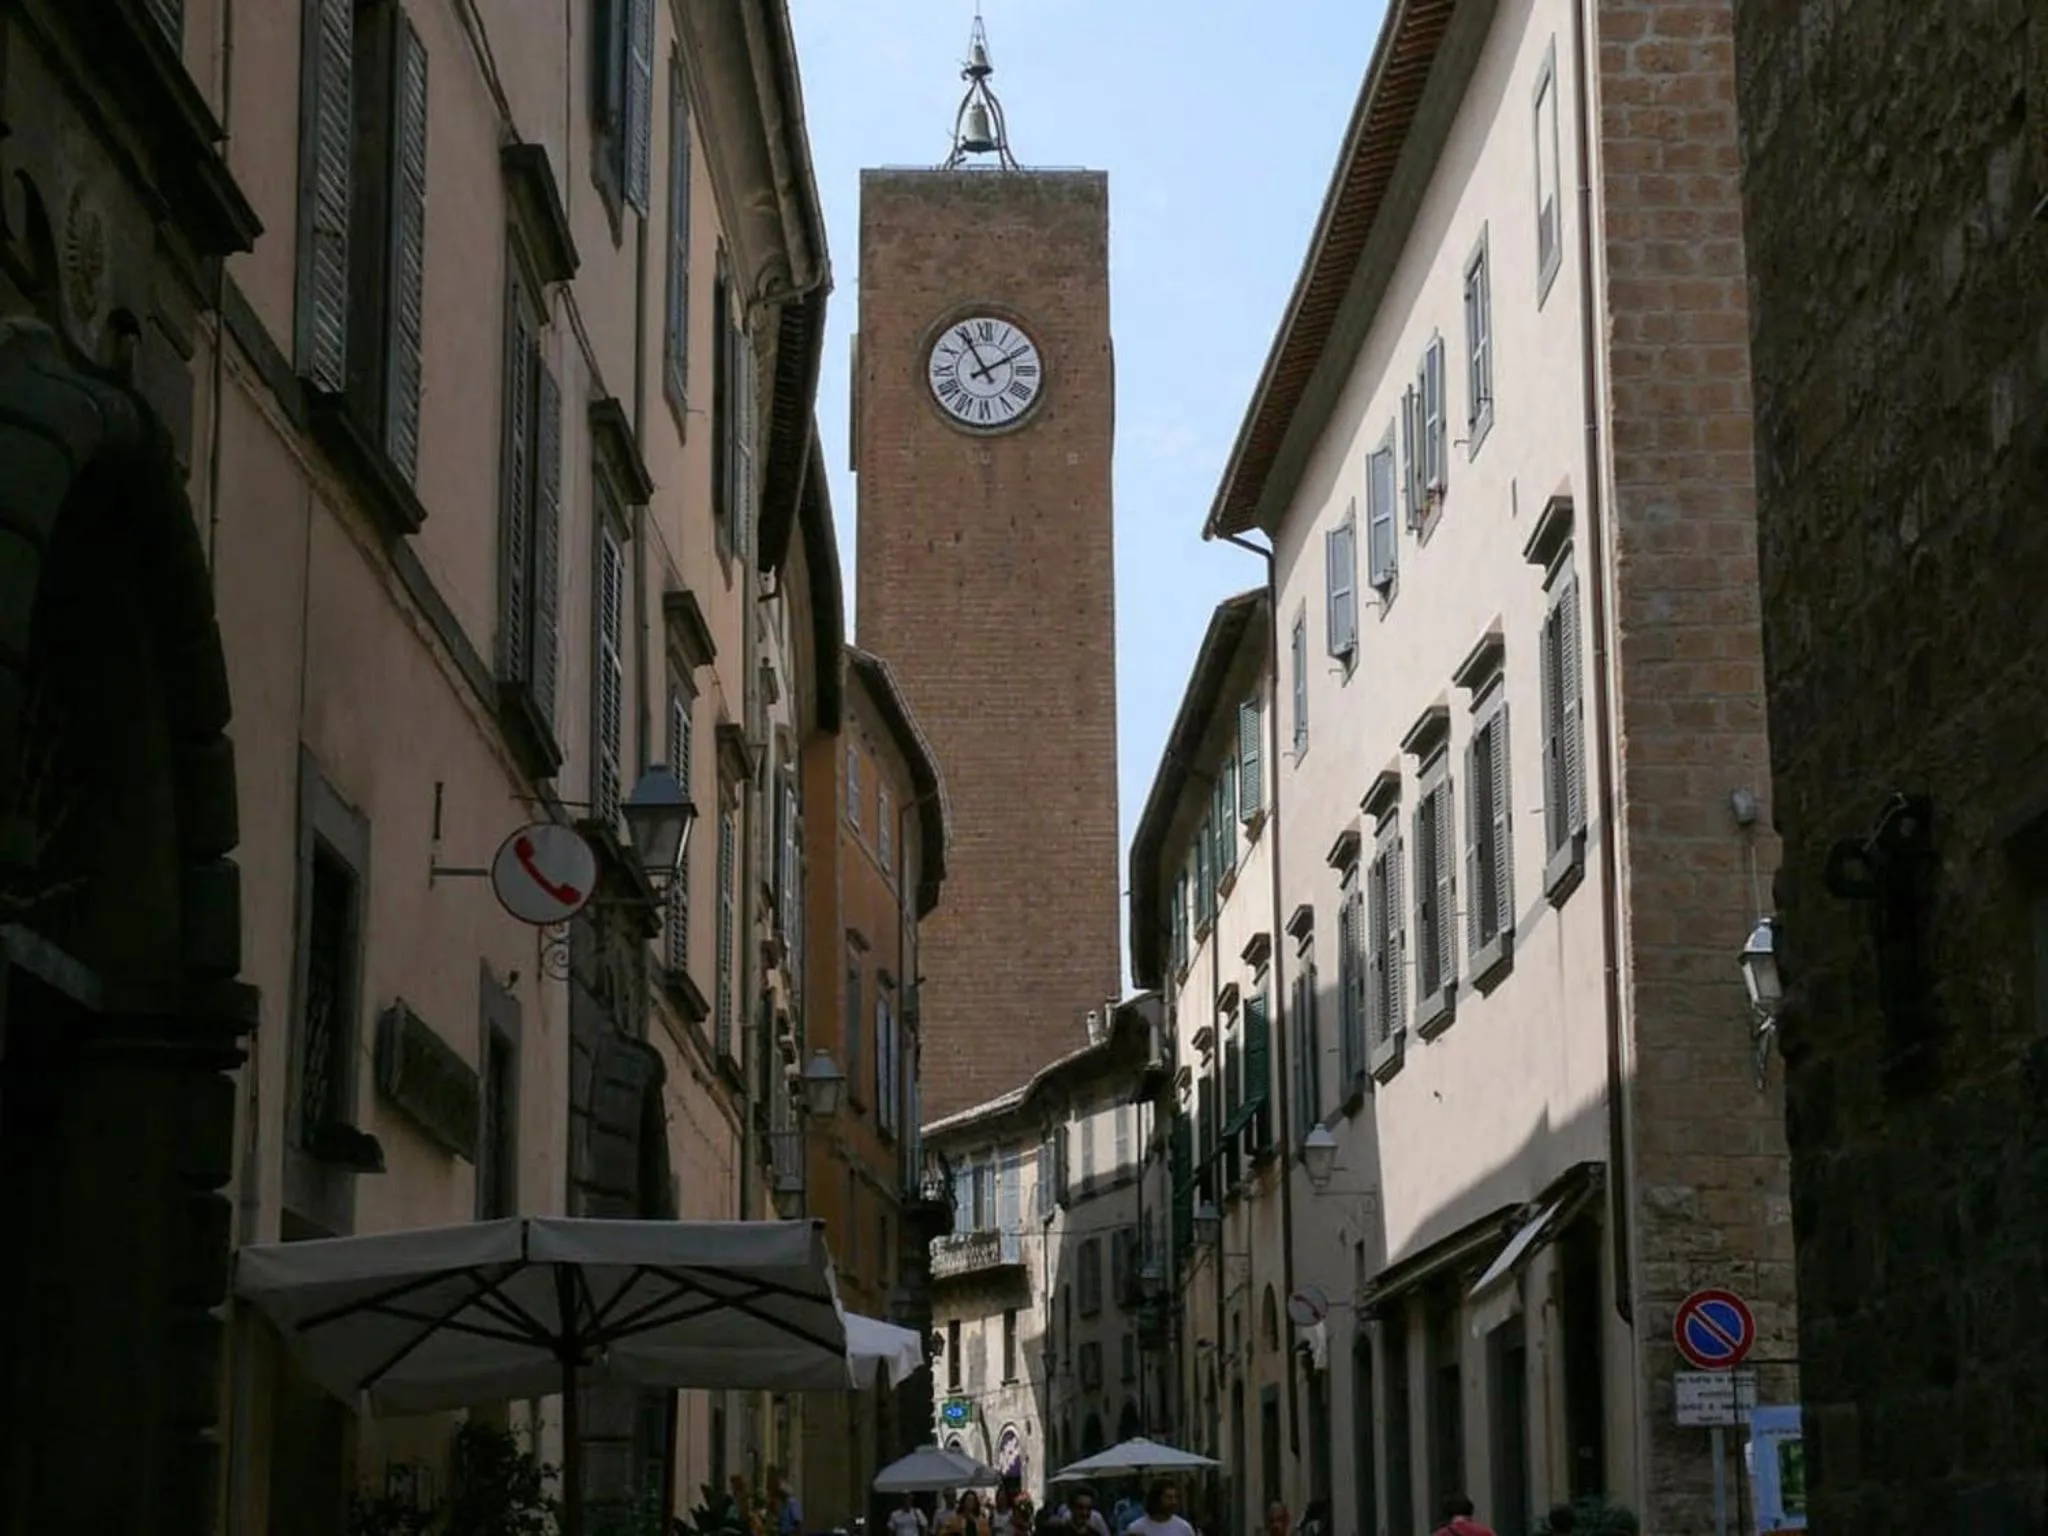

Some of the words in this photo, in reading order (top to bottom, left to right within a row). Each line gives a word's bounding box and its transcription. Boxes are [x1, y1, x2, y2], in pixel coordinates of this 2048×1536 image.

[976, 321, 994, 342] XII
[933, 364, 955, 377] IX
[1015, 365, 1037, 377] III
